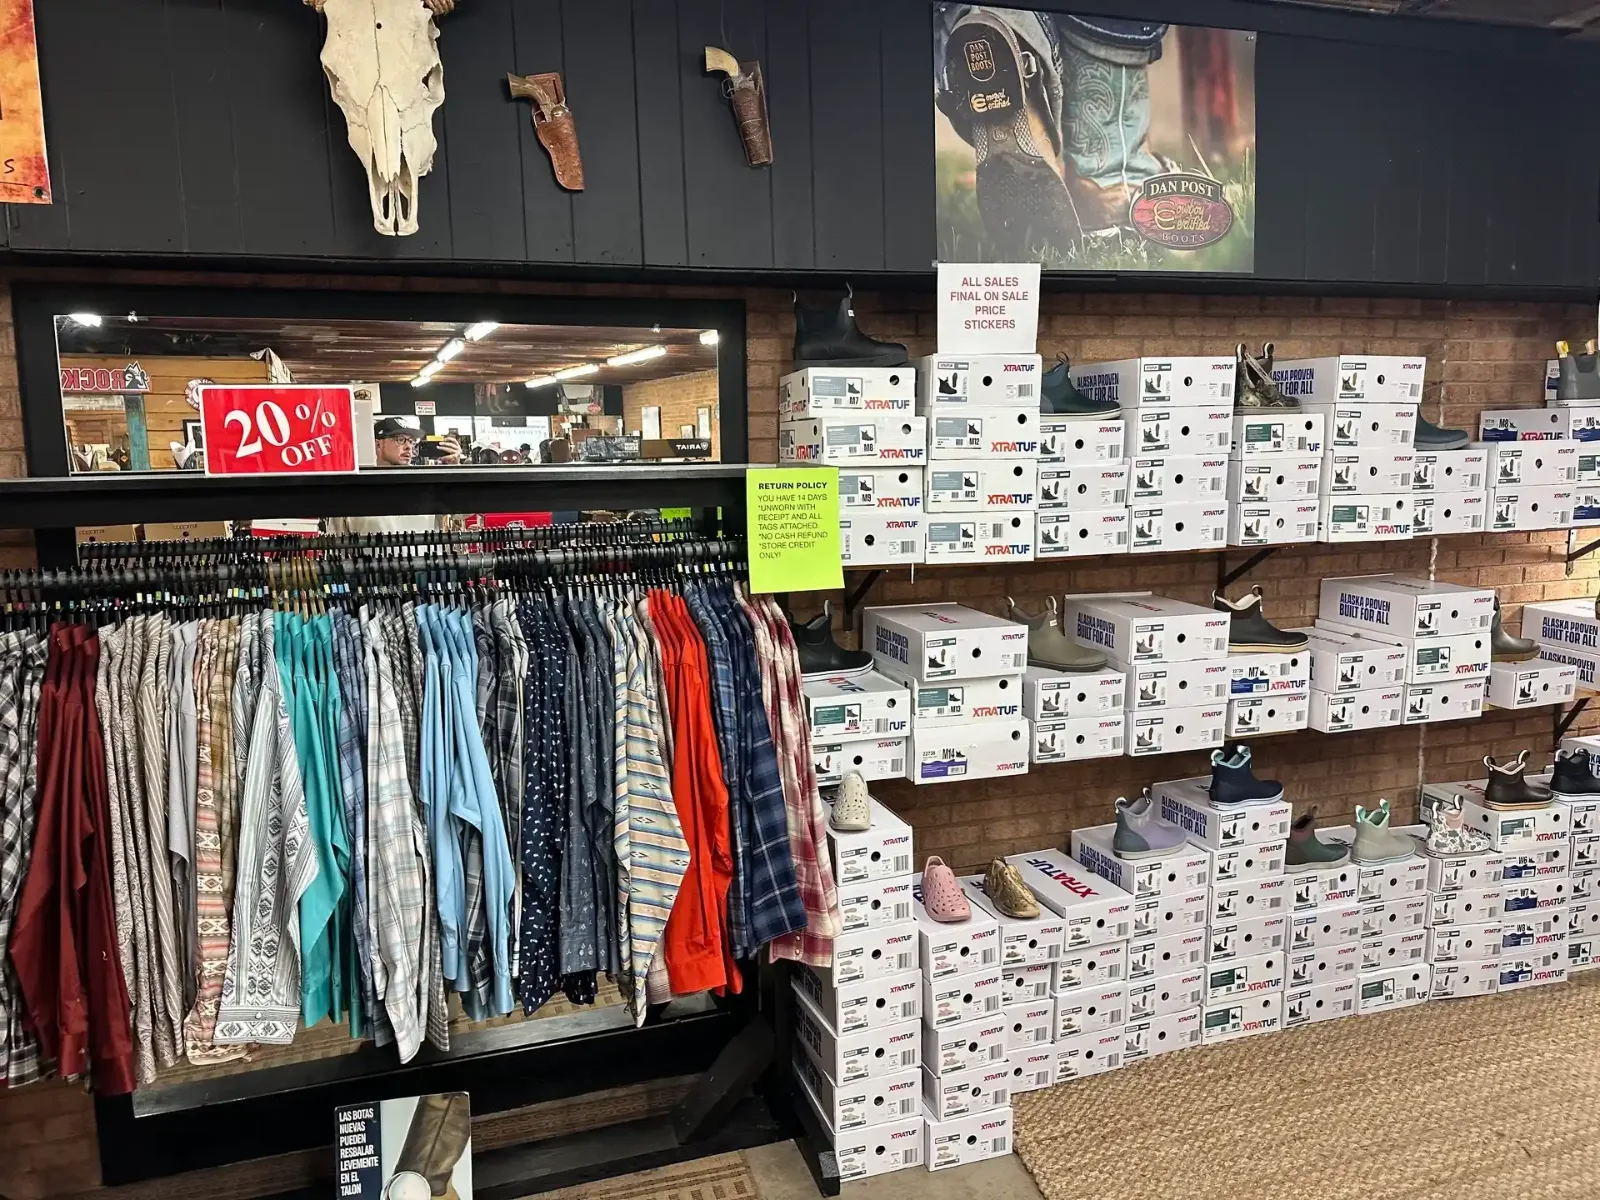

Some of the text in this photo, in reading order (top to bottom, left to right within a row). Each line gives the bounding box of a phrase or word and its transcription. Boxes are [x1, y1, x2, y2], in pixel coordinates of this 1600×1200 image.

[970, 43, 984, 52] DAN
[970, 52, 987, 61] POST
[971, 60, 992, 71] BOOTS
[1150, 181, 1213, 197] DAN POST
[1154, 199, 1204, 221] Cowboy
[1155, 210, 1211, 230] Certified
[1162, 233, 1205, 242] BOOTS
[961, 277, 1019, 287] ALL SALES
[950, 291, 1028, 301] FINAL ON SALE
[975, 305, 1006, 315] PRICE
[964, 319, 1016, 329] STICKERS
[1273, 368, 1314, 381] ASKA PROVEN
[1077, 373, 1119, 388] ALASKA PROVEN
[1285, 381, 1298, 395] FOR
[1300, 380, 1313, 394] ALL
[1095, 387, 1106, 401] FOR
[1108, 386, 1118, 400] ALL
[864, 400, 910, 410] XTRATUF
[1499, 419, 1508, 428] M8
[969, 437, 979, 445] M12
[281, 433, 333, 466] OFF
[864, 443, 873, 452] M8
[991, 442, 1037, 452] XTRATUF
[879, 449, 923, 459] XTRATUF
[877, 497, 920, 507] XTRATUF
[987, 494, 1032, 504] XTRATUF
[1374, 525, 1410, 534] XTRATUF
[984, 545, 1030, 555] XTRATUF
[1340, 593, 1390, 612] ALASKA PROVEN
[1339, 604, 1390, 625] BUILT FOR ALL
[1078, 612, 1115, 634] ALASKA PROVEN
[1542, 617, 1598, 636] ALASKA PROVEN
[876, 625, 891, 641] ALASKA
[892, 631, 908, 649] PROVEN
[1093, 629, 1103, 644] FOR
[1104, 633, 1114, 648] ALL
[1542, 627, 1597, 647] BUILT FOR ALL
[876, 637, 908, 664] BUILT FOR ALL
[1540, 651, 1595, 671] ALASKA PROVEN
[1249, 667, 1259, 677] M7
[1455, 662, 1488, 674] XTRATUF
[1580, 669, 1594, 683] ALL
[1271, 680, 1307, 690] XTRATUF
[972, 705, 1018, 717] XTRATUF
[849, 719, 857, 727] M8
[942, 748, 954, 759] M14
[996, 762, 1025, 771] XTRATUF
[1162, 796, 1207, 825] ALASKA PROVEN
[1162, 806, 1206, 838] BUILT FOR ALL
[883, 836, 909, 846] XTRATUF
[1536, 831, 1567, 841] XTRATUF
[1259, 844, 1284, 853] XTRATUF
[1519, 856, 1527, 864] W6
[1537, 865, 1565, 875] XTRATUF
[1026, 858, 1100, 898] XTRATUF
[883, 885, 909, 894] XTRATUF
[1260, 881, 1284, 889] XTRATUF
[1325, 889, 1355, 901] XTRATUF
[1520, 888, 1529, 897] W7
[1537, 897, 1566, 908] XTRATUF
[886, 935, 912, 944] XTRATUF
[972, 929, 996, 940] XTRATUF
[1401, 934, 1424, 943] XTRATUF
[1536, 933, 1566, 944] XTRATUF
[1534, 969, 1565, 980] XTRATUF
[1247, 978, 1281, 992] XTRATUF
[1243, 1018, 1277, 1031] XTRATUF
[889, 1032, 914, 1043] XTRATUF
[339, 1108, 374, 1122] LAS BOTAS
[339, 1121, 365, 1133] NUEVAS
[981, 1120, 1006, 1130] XTRATUF
[340, 1133, 366, 1146] PUEDEN
[340, 1146, 374, 1159] RESBALAR
[341, 1156, 379, 1171] LEVEMENTE
[341, 1172, 359, 1184] EN EL
